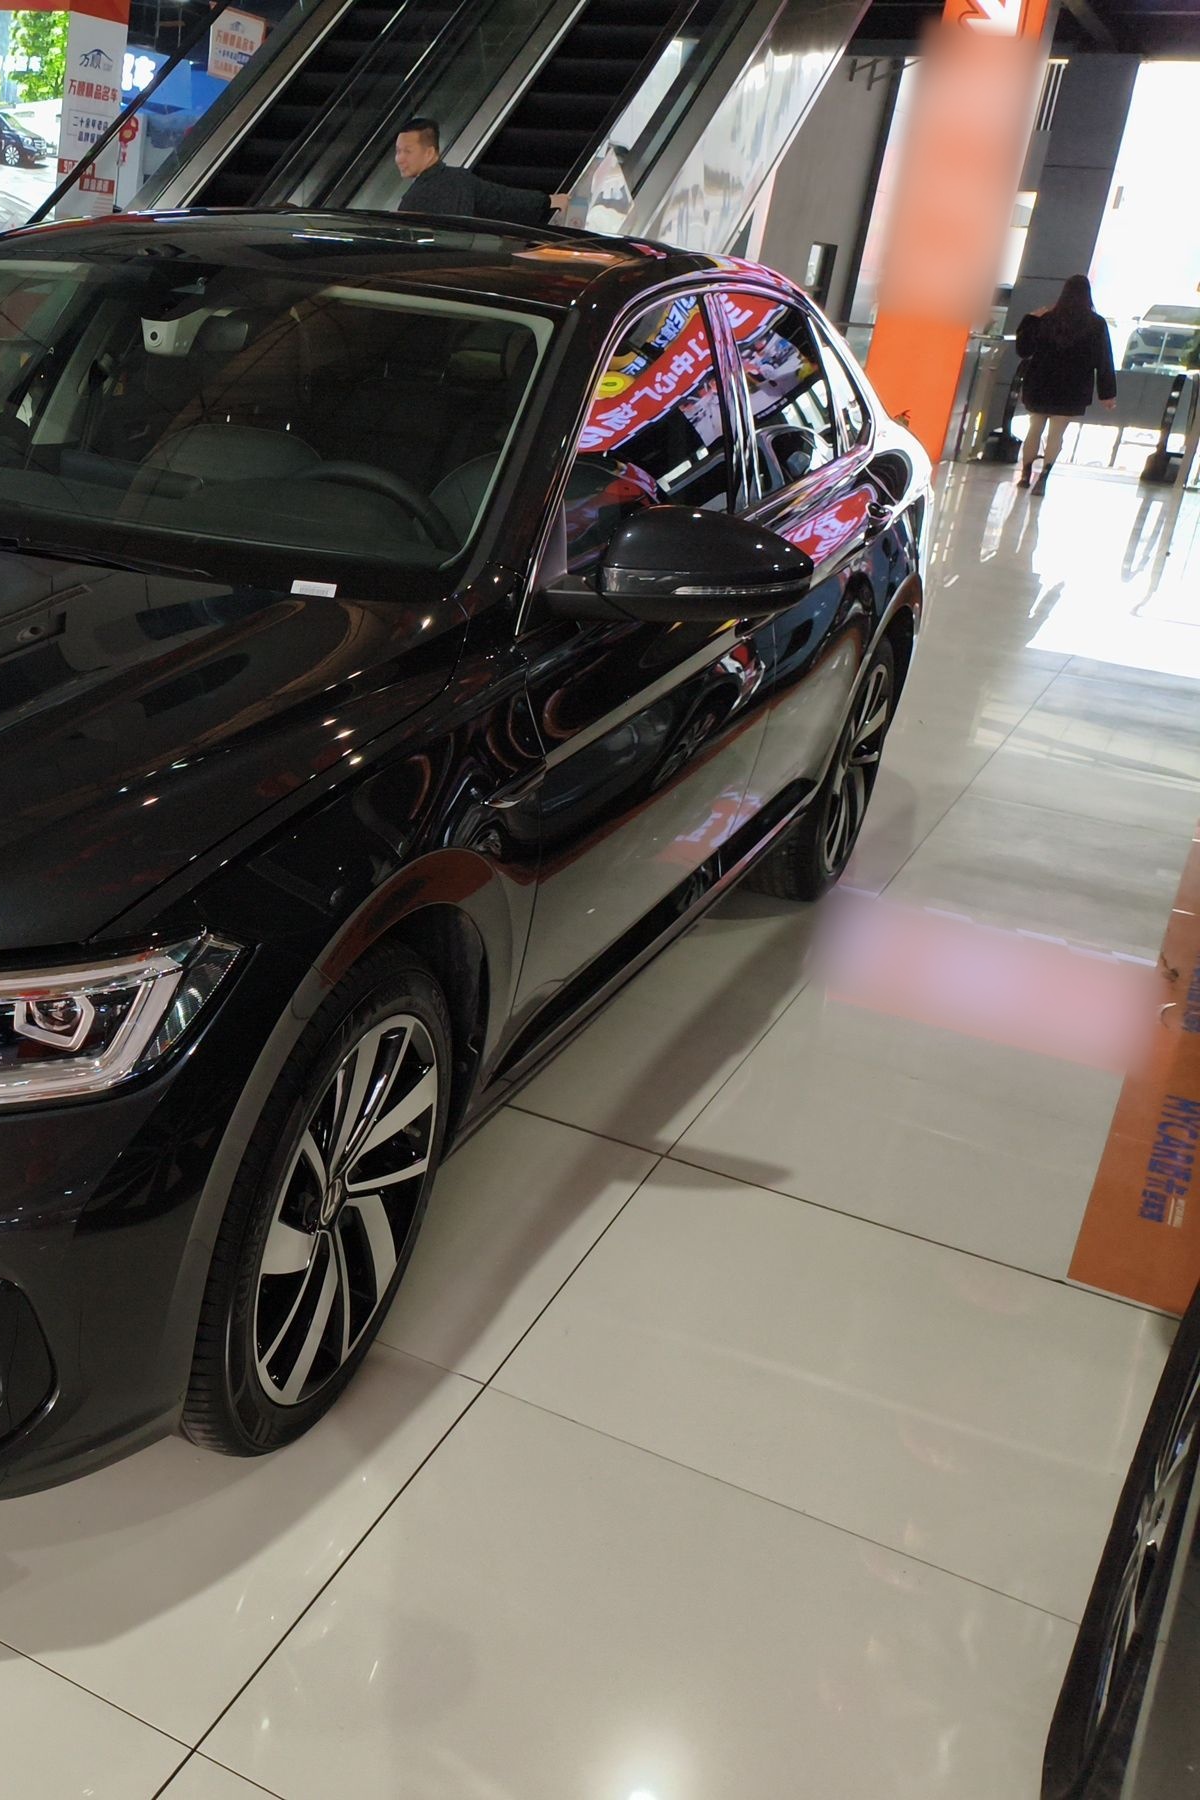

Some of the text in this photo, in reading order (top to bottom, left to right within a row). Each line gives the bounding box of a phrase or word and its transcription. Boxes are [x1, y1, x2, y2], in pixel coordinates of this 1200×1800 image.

[68, 79, 118, 102] 万顺精品名车
